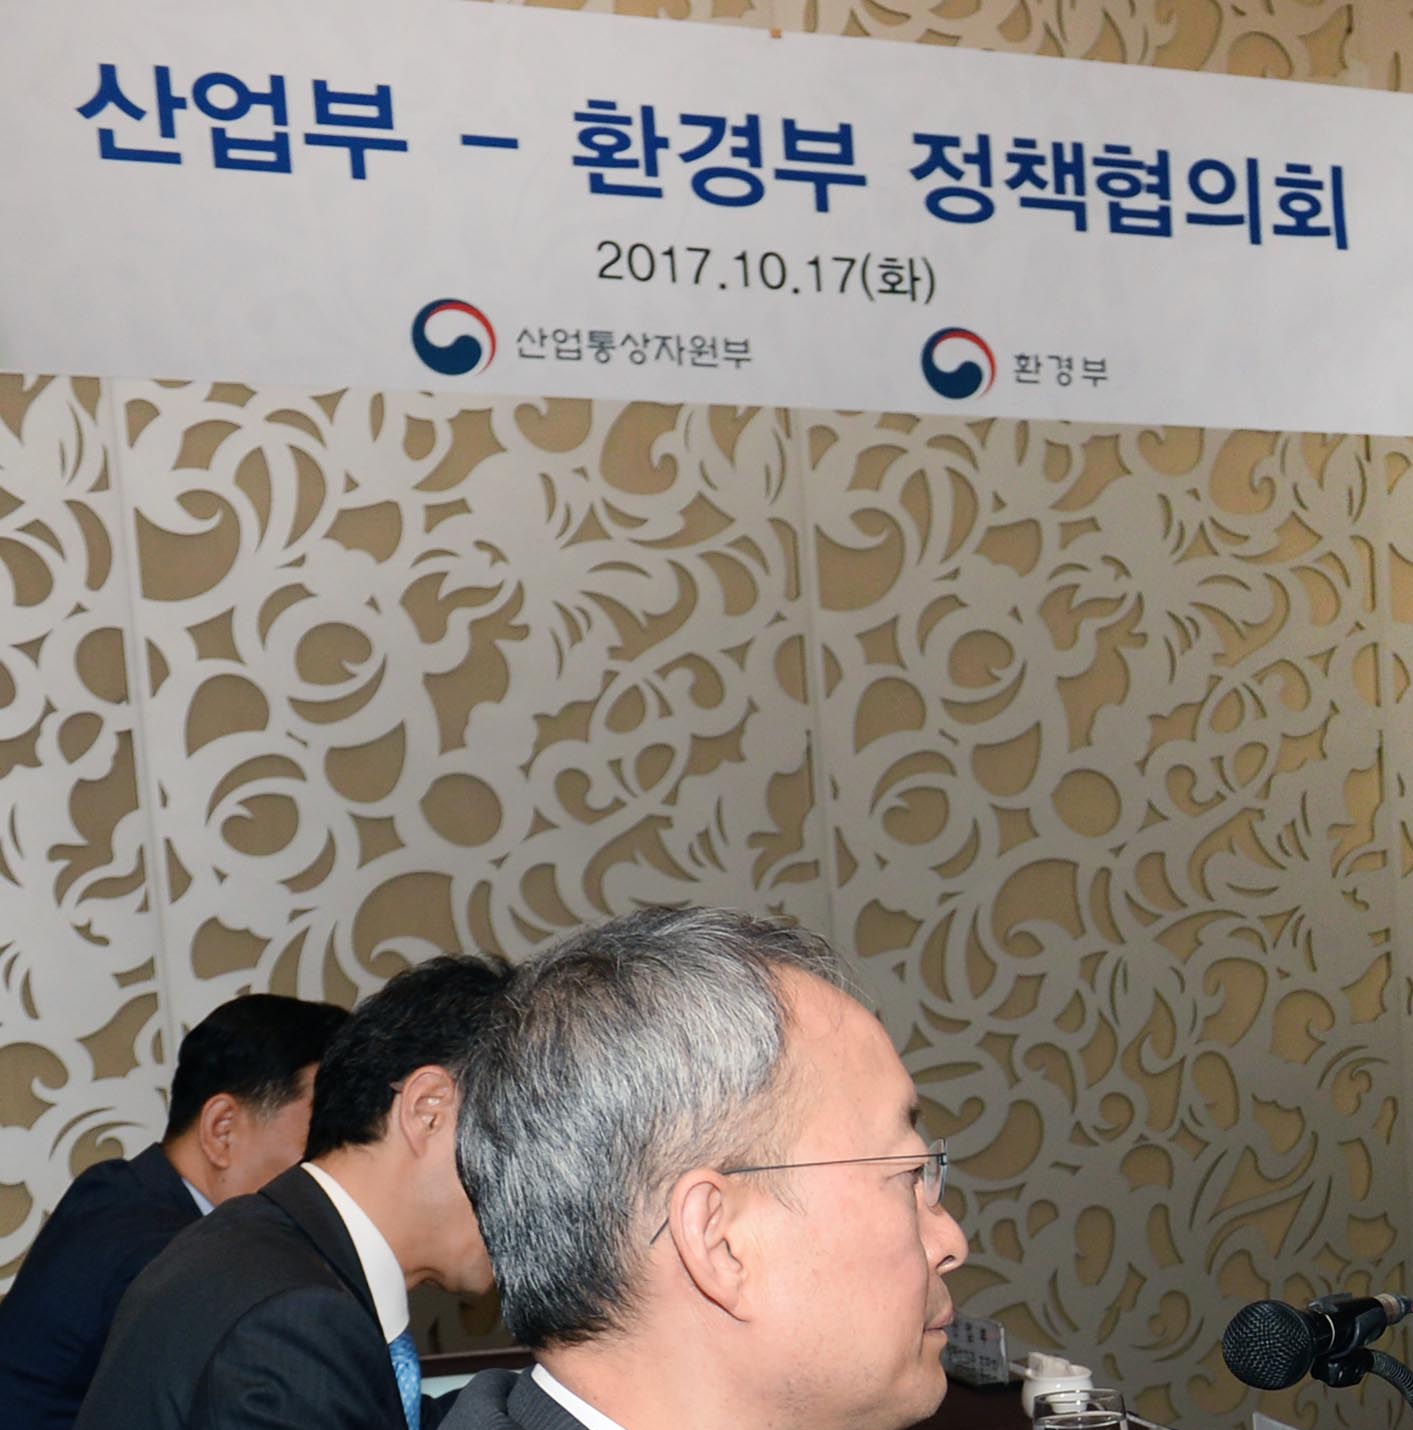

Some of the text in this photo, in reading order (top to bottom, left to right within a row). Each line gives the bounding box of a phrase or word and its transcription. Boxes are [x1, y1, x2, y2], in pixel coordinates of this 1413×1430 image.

[76, 64, 408, 180] 산업부
[572, 100, 867, 213] 환경부
[909, 133, 1351, 250] 정책협의회
[598, 241, 937, 305] 2017.10.17(화)
[516, 327, 753, 370] 산업통상자원부
[1013, 352, 1109, 388] 환경부
